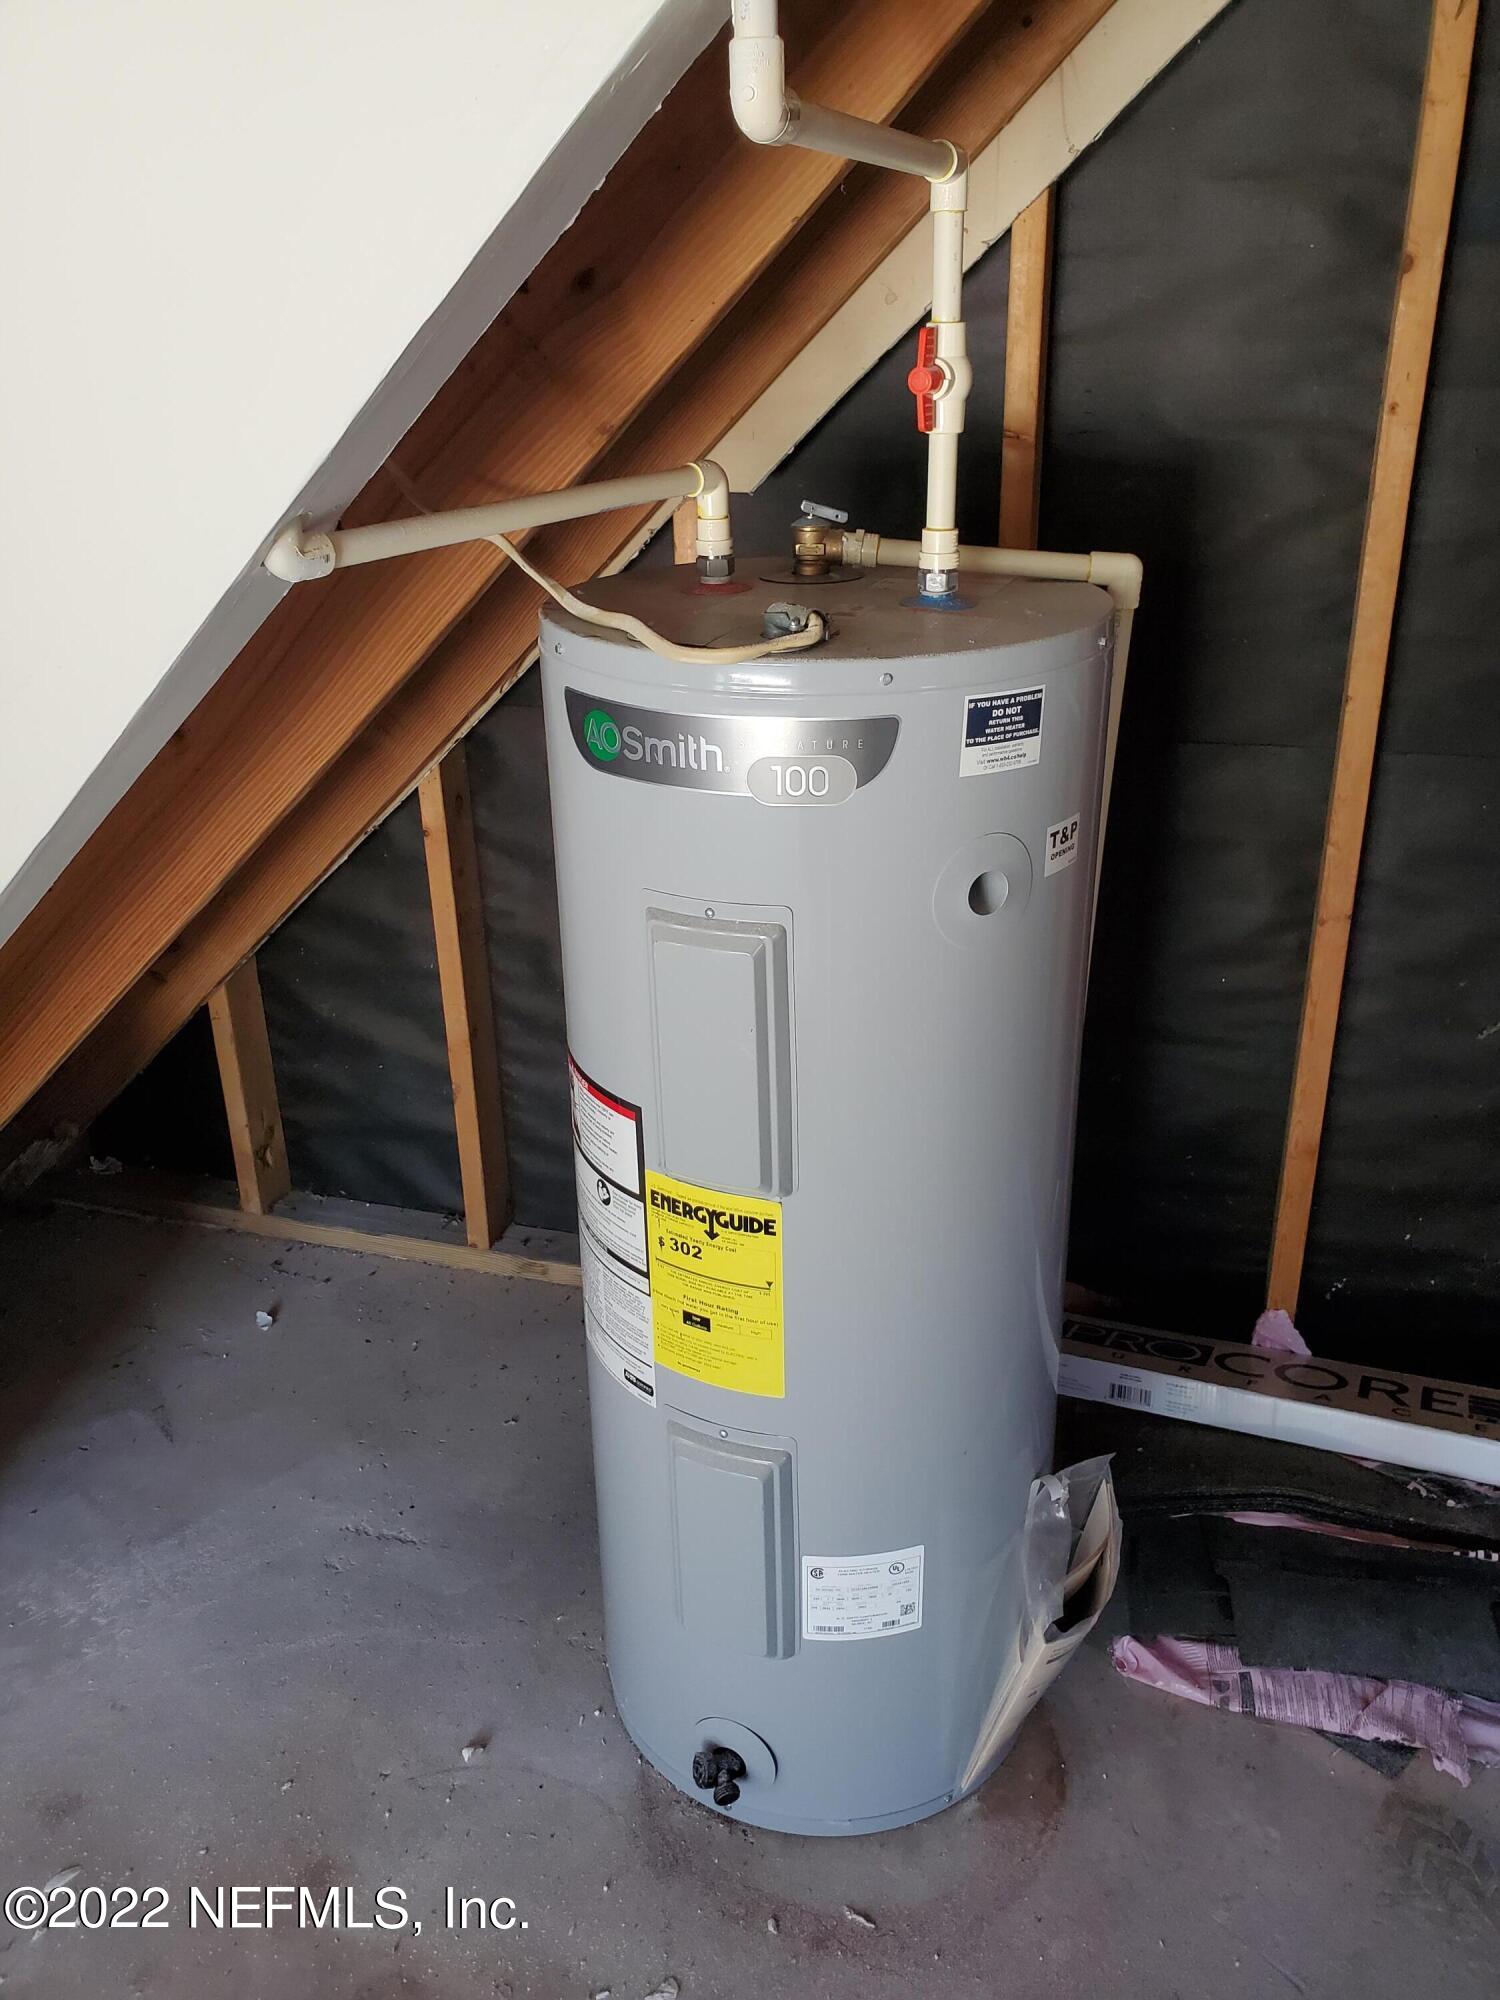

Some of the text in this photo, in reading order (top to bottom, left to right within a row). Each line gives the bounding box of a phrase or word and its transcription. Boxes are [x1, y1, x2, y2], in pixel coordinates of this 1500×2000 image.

[976, 700, 991, 708] YOU
[992, 698, 1010, 706] HAVE
[1016, 692, 1042, 702] PROBLEM
[992, 706, 1022, 717] DO NOT
[985, 726, 1004, 734] WATER
[988, 718, 1010, 726] RETURN
[975, 736, 986, 744] THE
[987, 734, 1004, 742] PLACE
[770, 765, 829, 797] 100
[1050, 821, 1078, 848] T&P
[1050, 843, 1075, 860] OPENING
[650, 1188, 776, 1240] ENERGYGUIDE
[658, 1236, 665, 1248] $
[669, 1237, 703, 1260] 302
[683, 1294, 739, 1315] First Hour Rating
